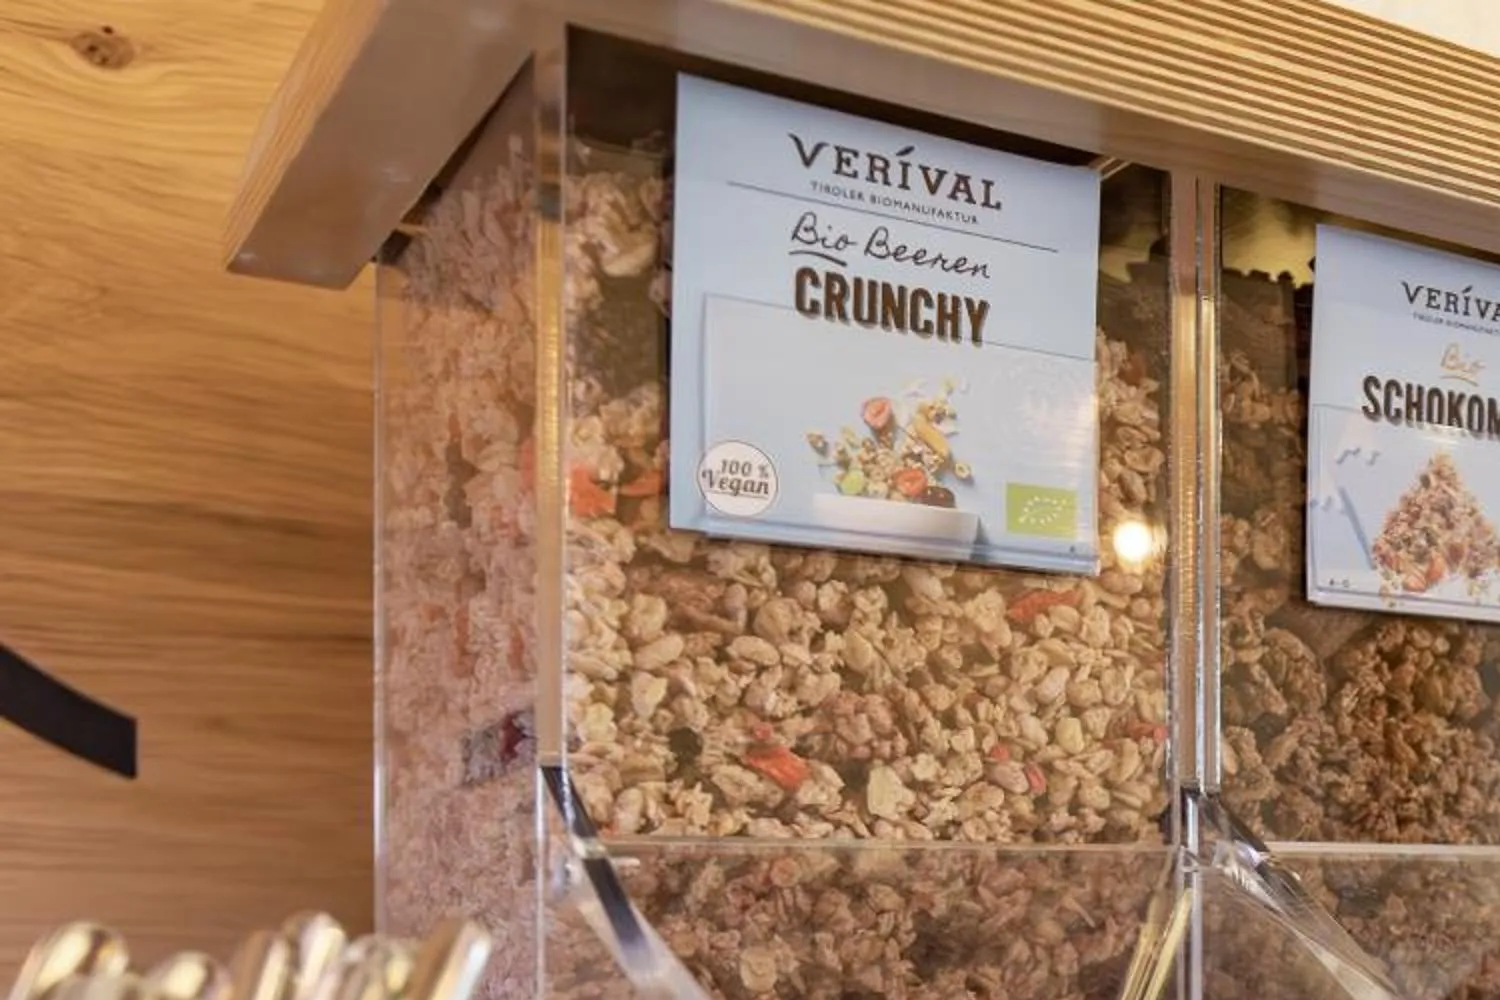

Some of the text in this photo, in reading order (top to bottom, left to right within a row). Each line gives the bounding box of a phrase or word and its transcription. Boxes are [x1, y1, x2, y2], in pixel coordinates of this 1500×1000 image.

[788, 133, 1003, 211] VERÍVAL
[809, 180, 980, 225] TIROLER BIOMANUFAKTUR
[791, 211, 992, 280] Bio Beeren
[794, 266, 992, 347] CRUNCHY
[701, 468, 769, 496] Vegan
[720, 459, 752, 477] 100
